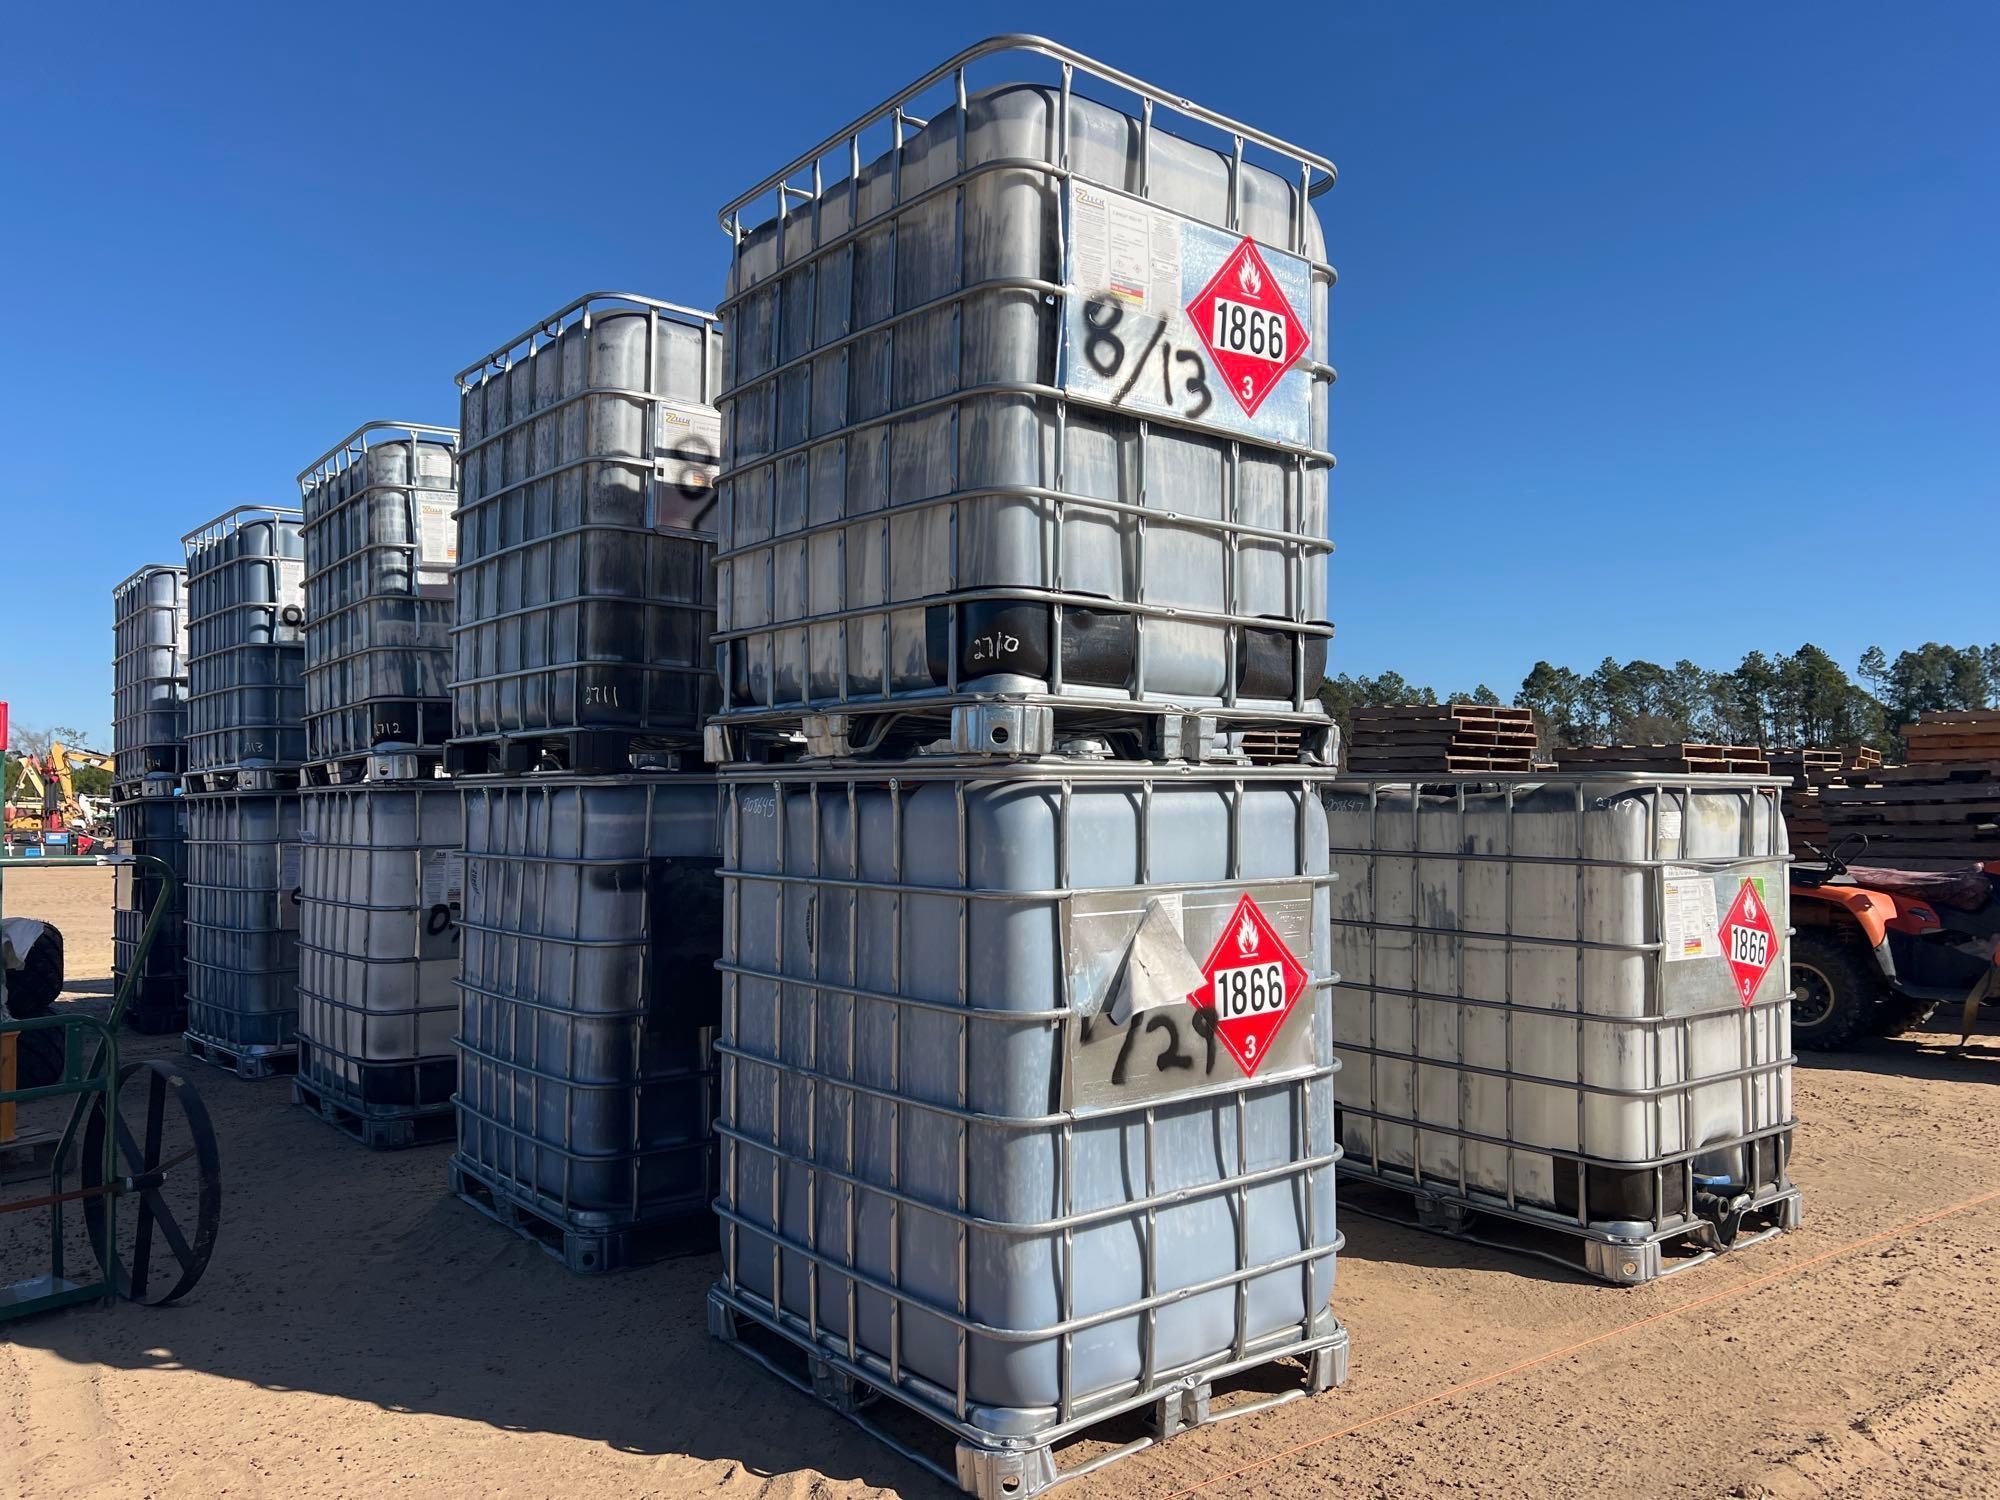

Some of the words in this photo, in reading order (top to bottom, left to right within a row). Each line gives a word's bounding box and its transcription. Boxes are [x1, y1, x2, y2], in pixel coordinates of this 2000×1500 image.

[1217, 301, 1284, 359] 1866
[1083, 292, 1213, 418] 8/13
[1242, 375, 1254, 400] 3
[973, 631, 1020, 660] 2710
[585, 685, 618, 707] 2711
[1733, 926, 1767, 966] 1866
[1218, 965, 1283, 1018] 1866
[1743, 977, 1751, 995] 3
[1244, 1034, 1256, 1059] 3
